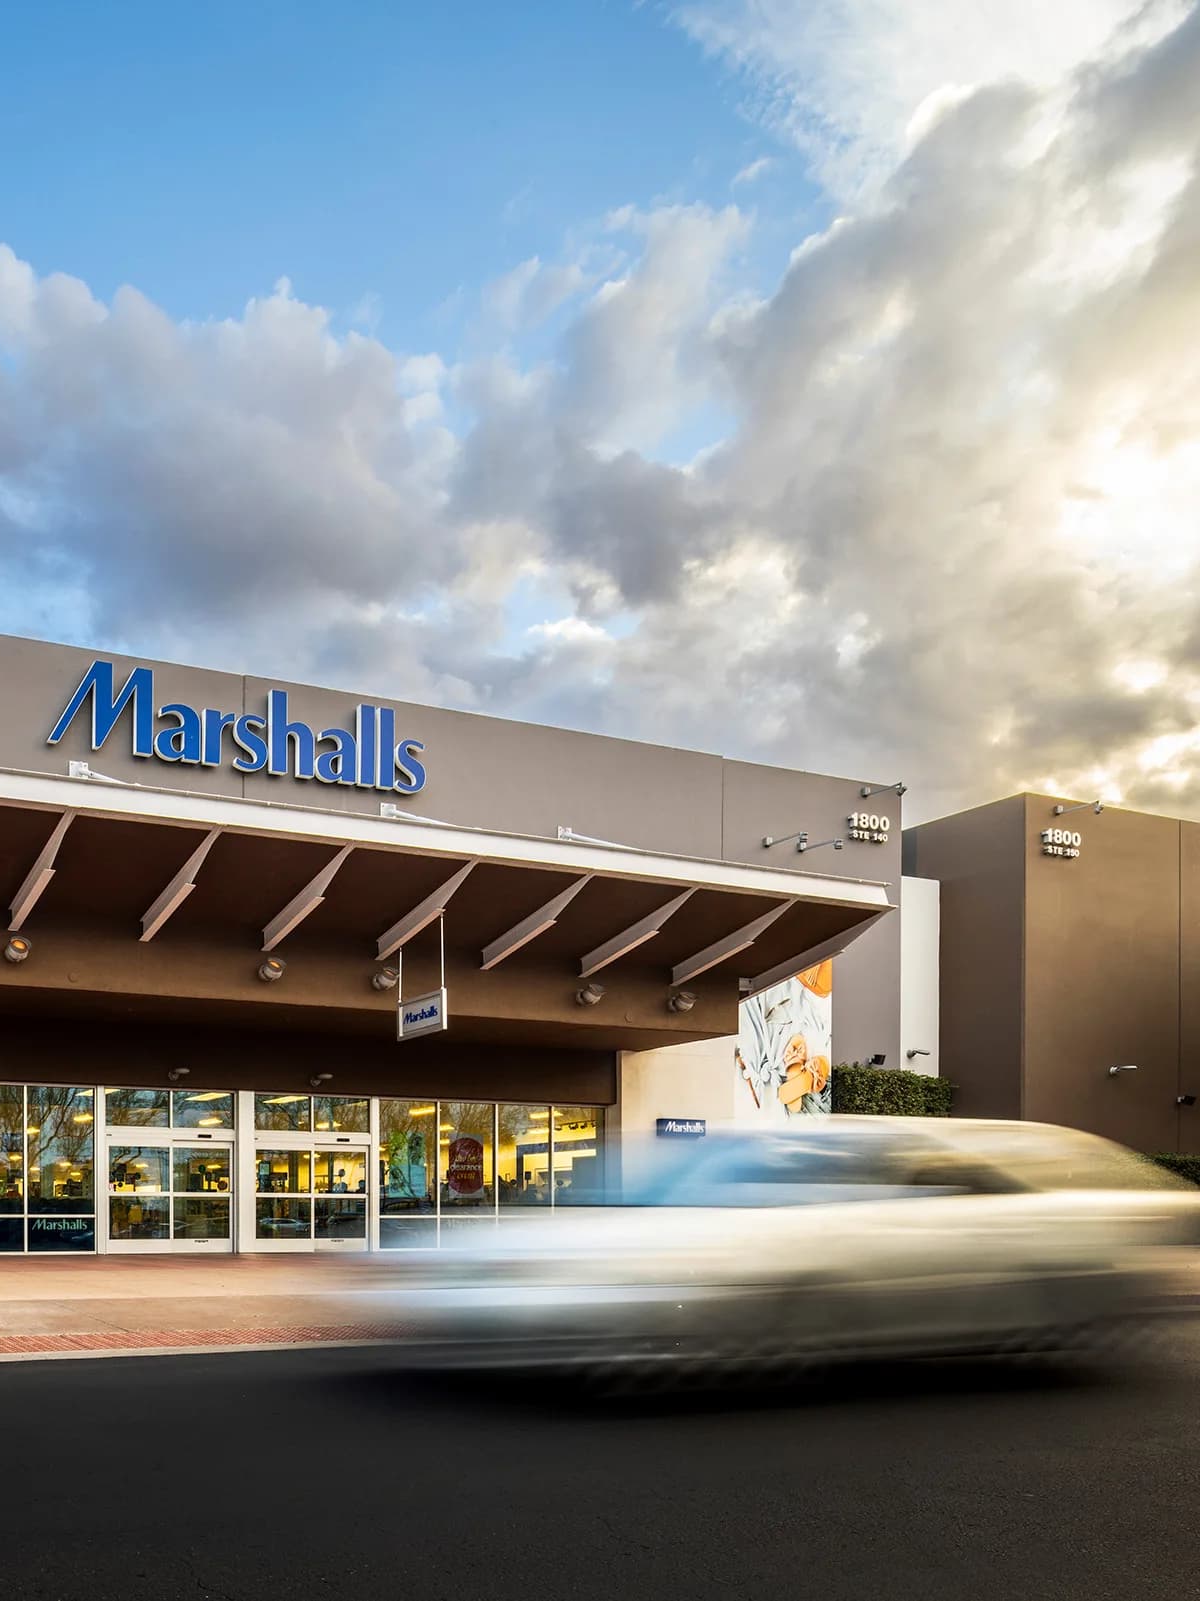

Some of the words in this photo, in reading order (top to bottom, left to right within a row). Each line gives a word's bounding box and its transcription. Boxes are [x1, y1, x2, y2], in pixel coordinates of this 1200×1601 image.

[47, 660, 427, 795] Marshalls
[849, 812, 890, 831] 1800
[852, 830, 870, 840] STE
[873, 833, 888, 842] 140
[1042, 828, 1081, 847] 1800
[1047, 845, 1063, 855] STE
[403, 1005, 438, 1025] Marshalls
[665, 1121, 705, 1134] Marshalls
[31, 1218, 88, 1231] Marshalls
